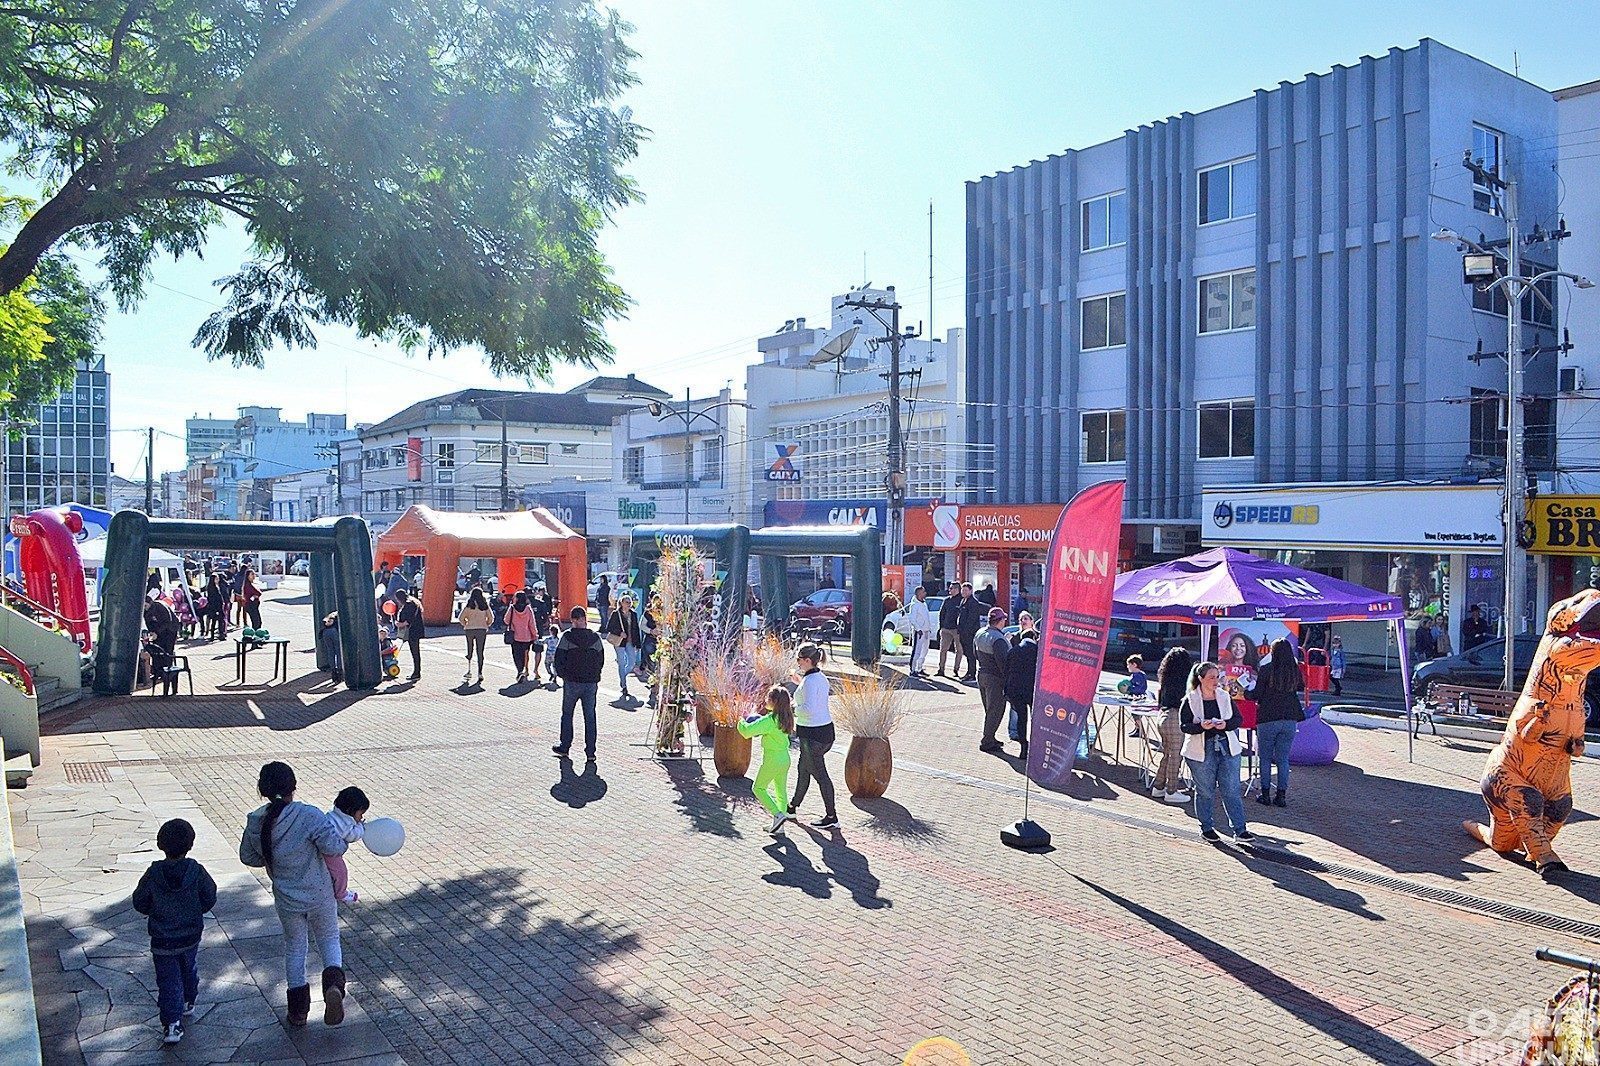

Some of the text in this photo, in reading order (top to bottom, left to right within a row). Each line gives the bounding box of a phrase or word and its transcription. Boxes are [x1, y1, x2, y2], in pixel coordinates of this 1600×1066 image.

[769, 471, 799, 480] CAIXA
[828, 507, 878, 526] CAIXA
[1547, 503, 1596, 518] Casa
[965, 512, 1021, 526] FARMÁCIAS
[663, 533, 694, 547] SICOOB
[965, 529, 999, 541] SANTA
[1059, 545, 1109, 577] KNN
[1256, 577, 1321, 596] KNN
[1060, 624, 1097, 638] NOVO IDIOMA
